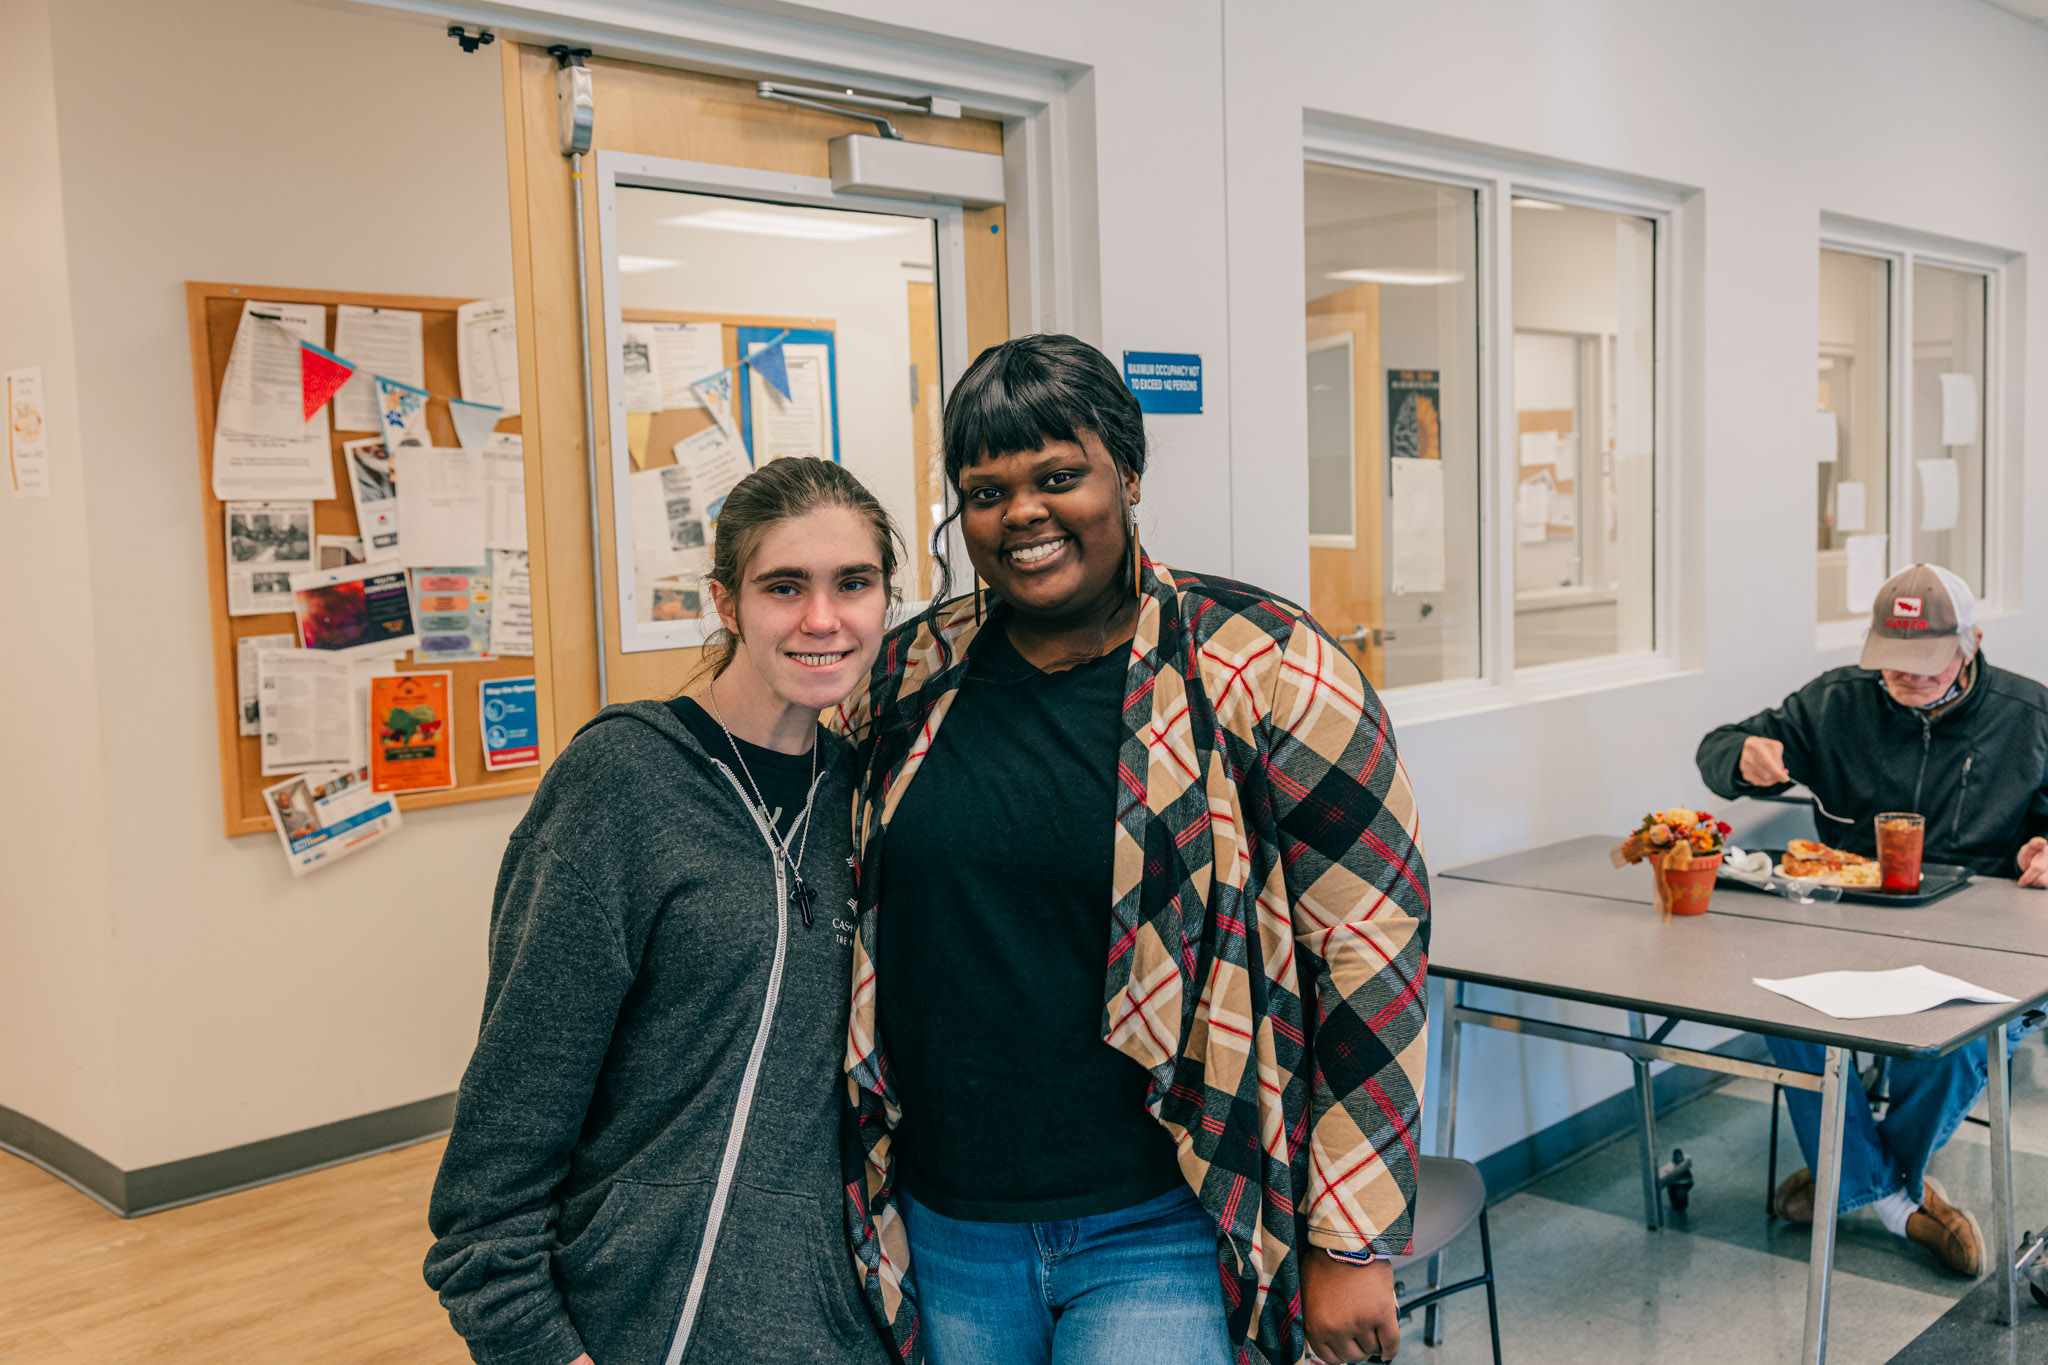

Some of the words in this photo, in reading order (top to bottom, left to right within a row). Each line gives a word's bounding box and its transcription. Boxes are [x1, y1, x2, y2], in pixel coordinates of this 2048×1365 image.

[1128, 364, 1154, 375] MAXIMUM
[1156, 364, 1188, 376] OCCUPANCY
[1189, 366, 1200, 377] NOT
[1131, 378, 1139, 390] TO
[1140, 379, 1162, 391] EXCEED
[1172, 380, 1198, 392] PERSONS
[1885, 618, 1928, 630] COSTA
[836, 934, 848, 946] THE
